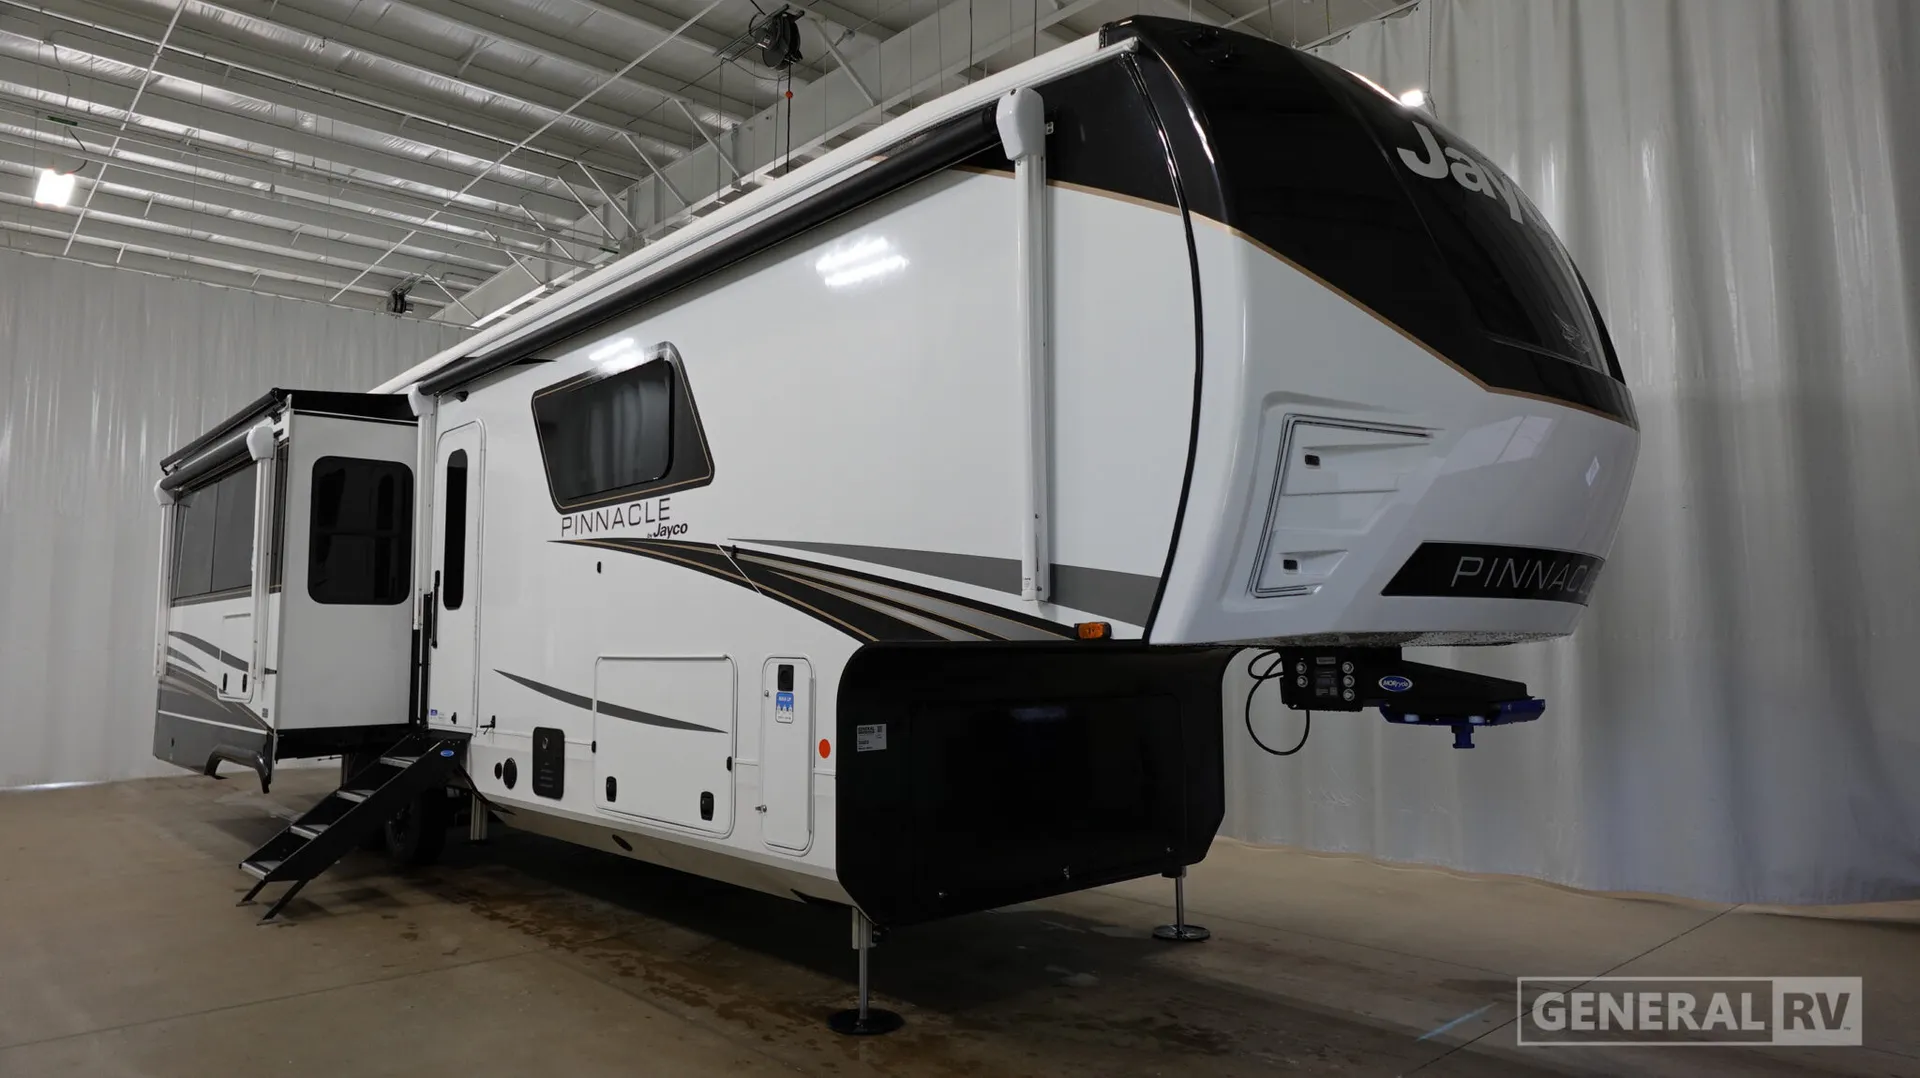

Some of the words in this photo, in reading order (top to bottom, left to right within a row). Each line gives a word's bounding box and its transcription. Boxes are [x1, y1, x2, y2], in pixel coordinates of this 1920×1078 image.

[561, 497, 671, 537] PINNACLE
[653, 522, 688, 539] Jayco
[1450, 556, 1593, 594] PINNACL
